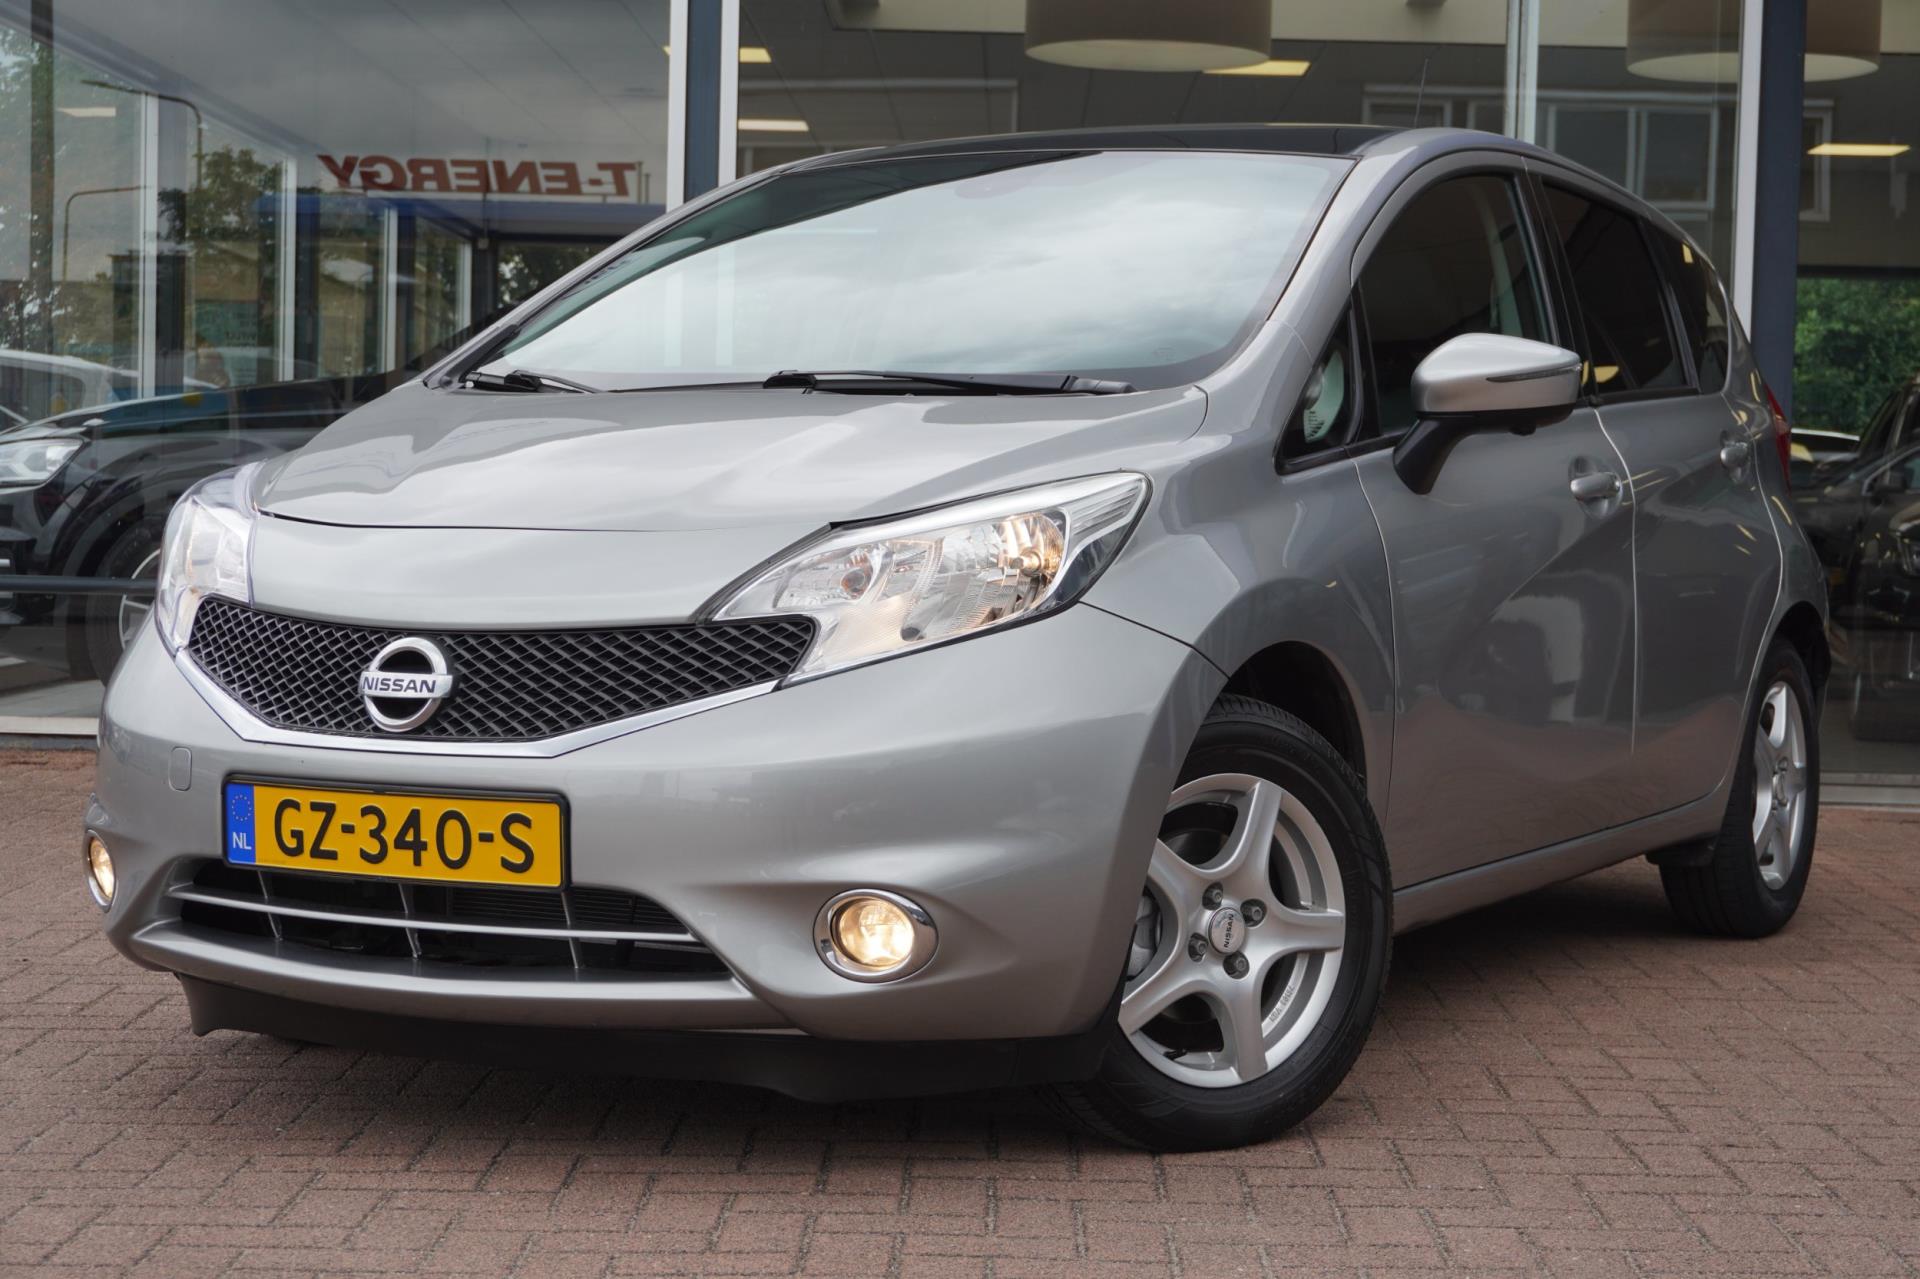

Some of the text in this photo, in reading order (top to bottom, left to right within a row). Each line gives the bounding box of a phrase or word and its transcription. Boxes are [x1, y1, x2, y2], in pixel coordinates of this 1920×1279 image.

[362, 676, 436, 694] NISSAN
[232, 831, 252, 850] NL
[274, 798, 534, 874] GZ-340-S
[1223, 913, 1234, 948] NISSAN
